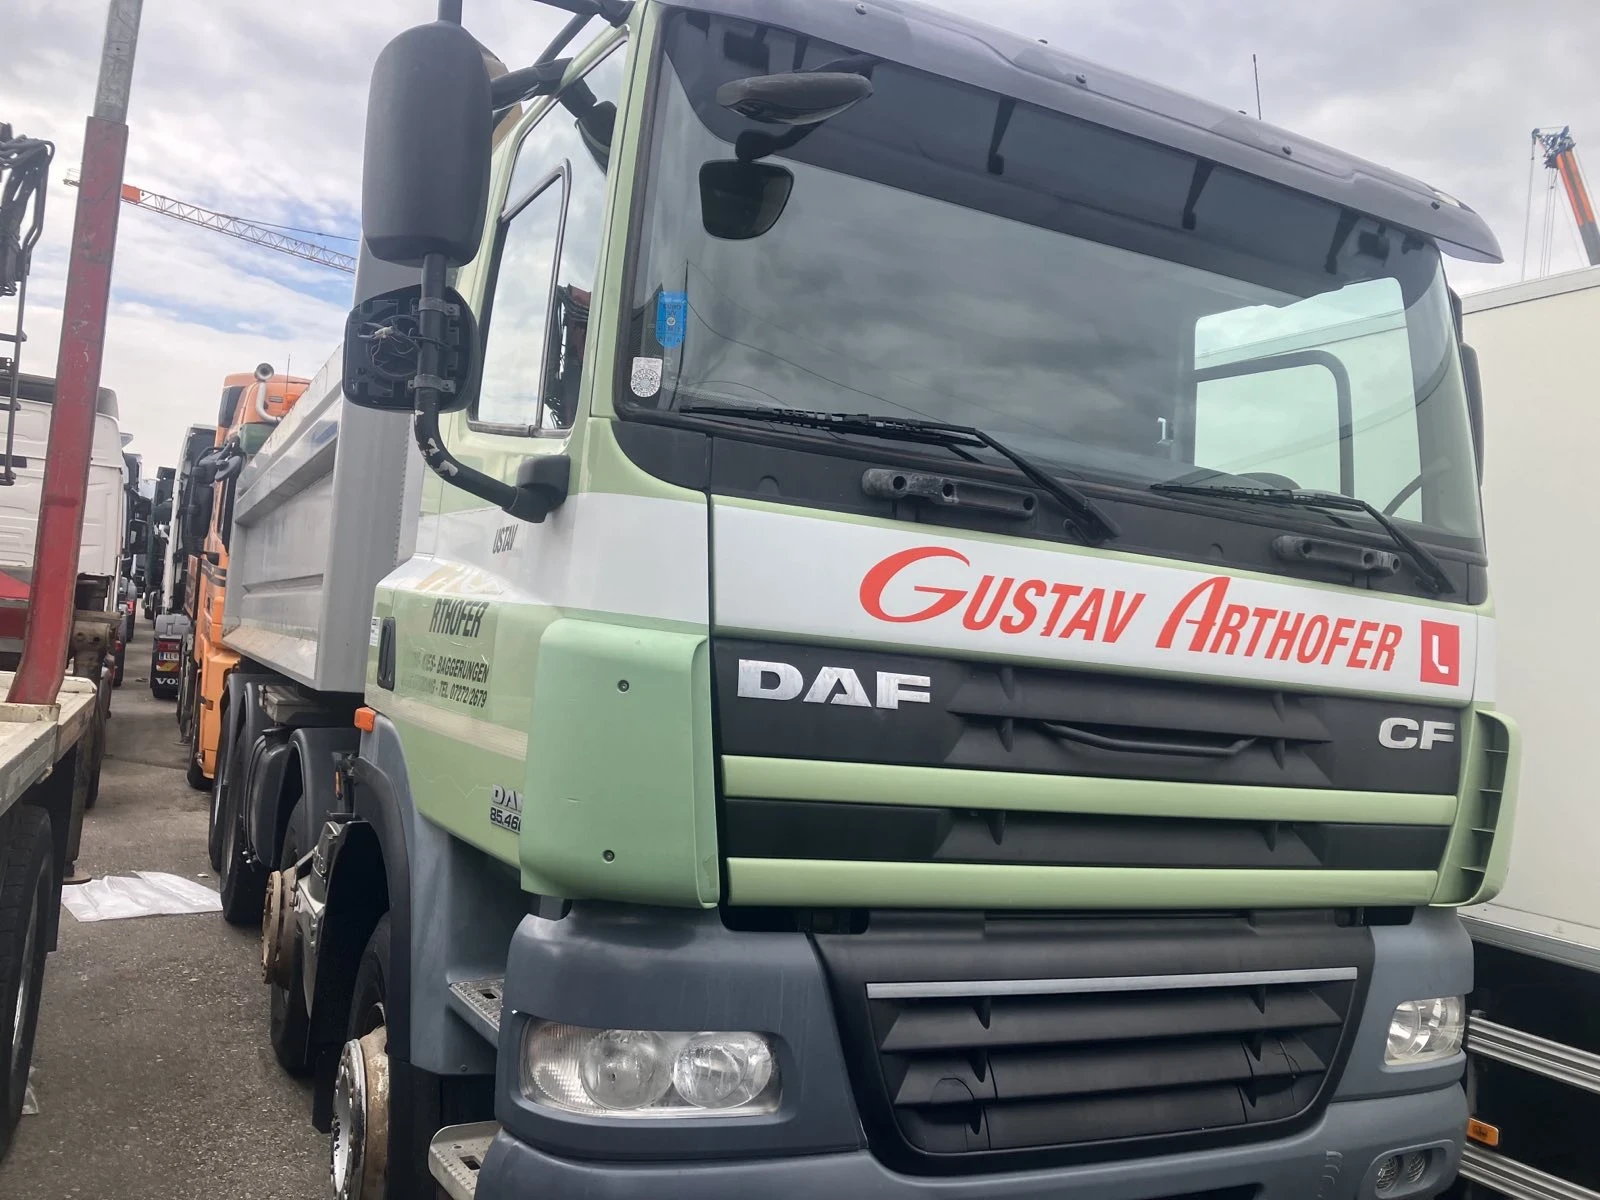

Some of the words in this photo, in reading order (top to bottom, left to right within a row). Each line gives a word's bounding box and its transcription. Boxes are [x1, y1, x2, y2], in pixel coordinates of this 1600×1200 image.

[859, 546, 1147, 643] GUSTAV
[1155, 576, 1403, 671] ARTHOFER
[436, 656, 490, 684] BAGGERUNGEN
[737, 659, 931, 710] DAF
[449, 683, 488, 708] 07272/2679
[1378, 717, 1456, 751] CF
